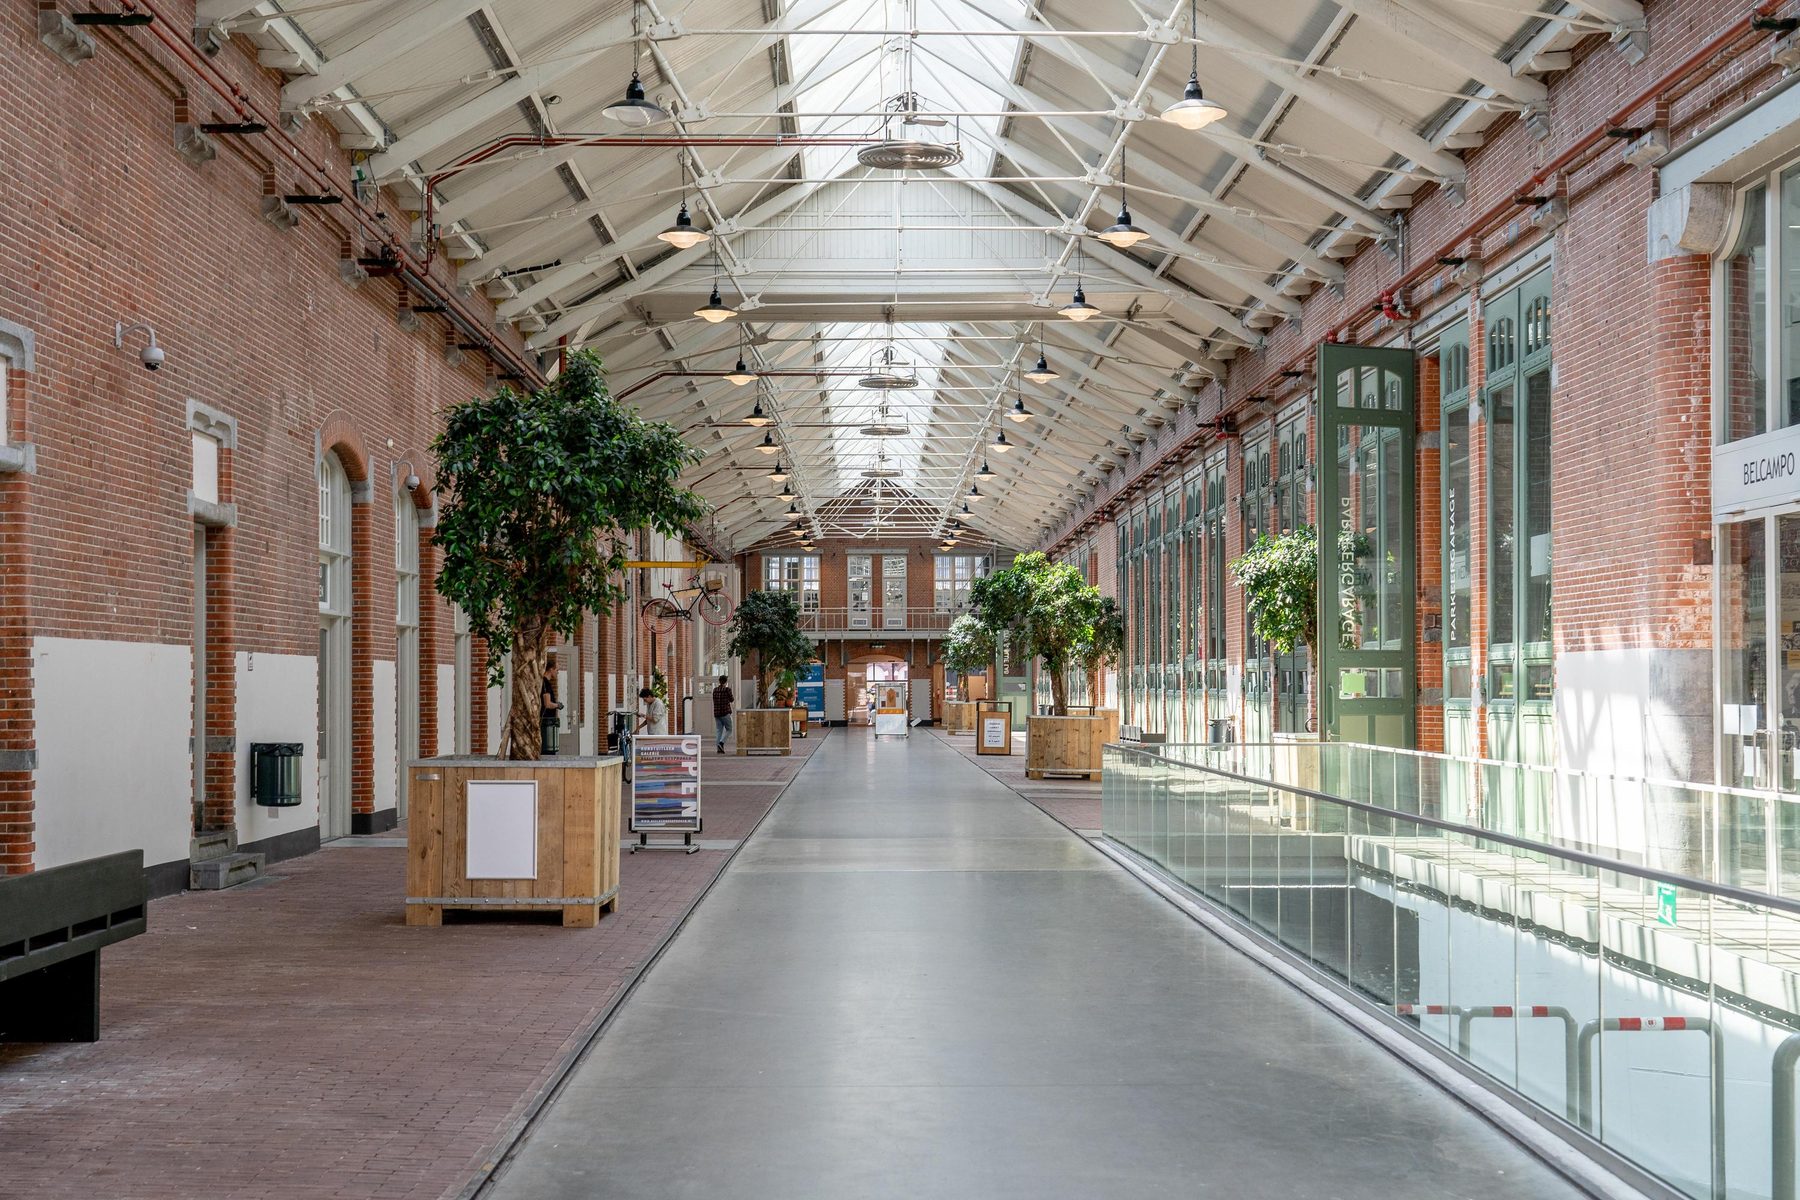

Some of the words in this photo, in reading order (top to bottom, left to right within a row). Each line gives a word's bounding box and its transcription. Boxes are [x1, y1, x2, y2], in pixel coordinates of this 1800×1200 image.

[1743, 452, 1795, 486] BELCAMPO
[1449, 487, 1457, 640] PARKEERGARAGE
[681, 739, 698, 817] OPEN
